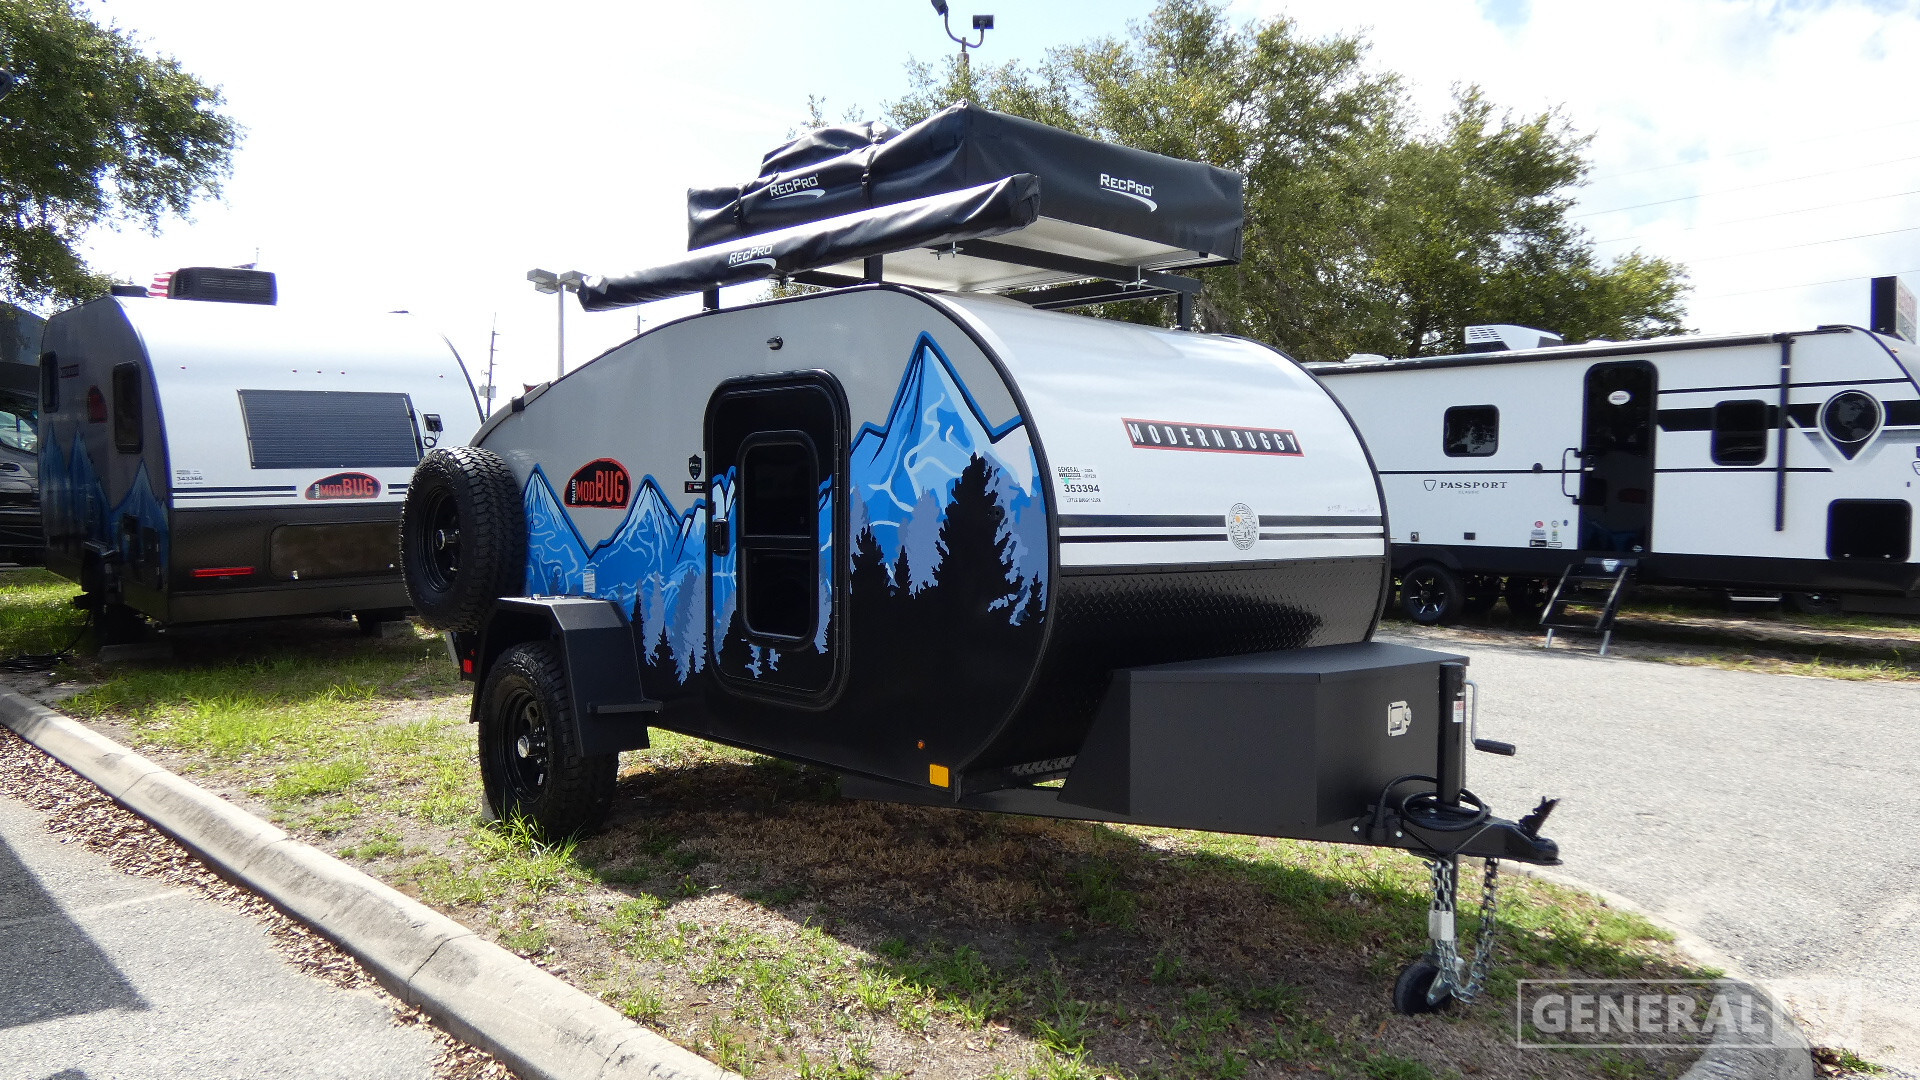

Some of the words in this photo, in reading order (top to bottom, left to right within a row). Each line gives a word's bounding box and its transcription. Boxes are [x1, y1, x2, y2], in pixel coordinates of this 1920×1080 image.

[1127, 422, 1226, 448] MODERN
[1230, 430, 1298, 452] BUGGY
[1063, 484, 1101, 493] 353394
[1440, 481, 1508, 489] PASSPORT
